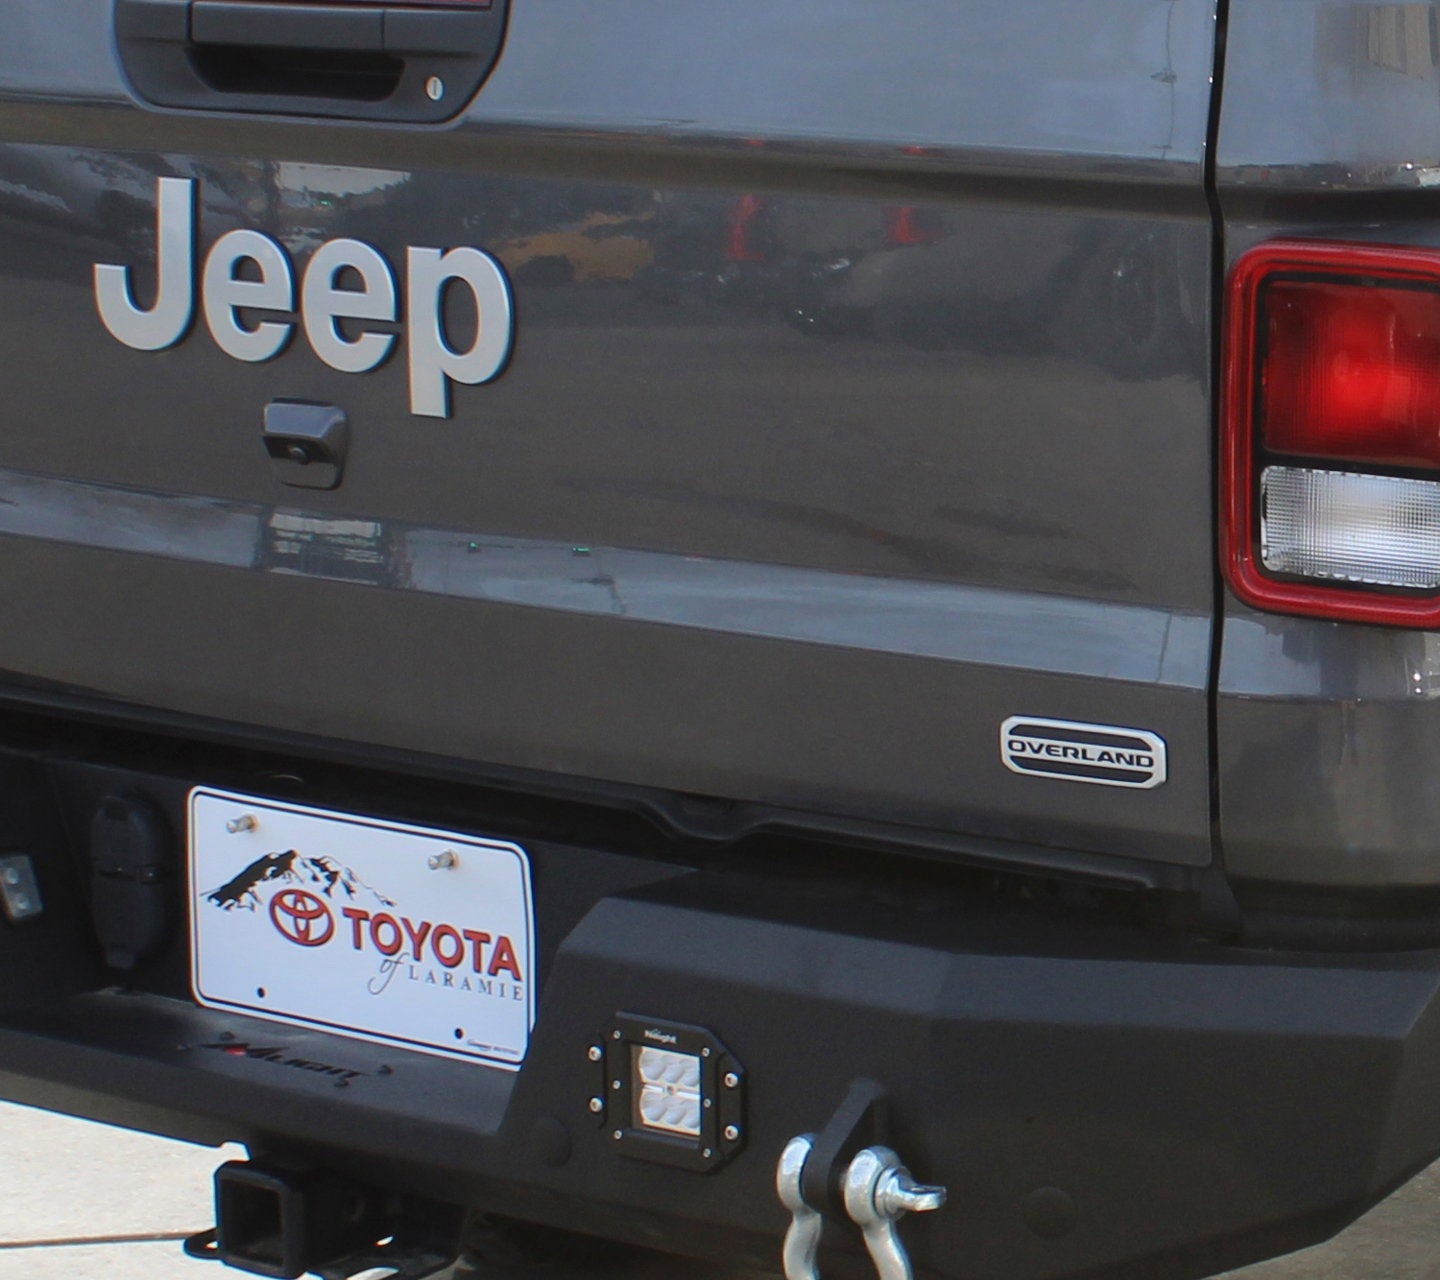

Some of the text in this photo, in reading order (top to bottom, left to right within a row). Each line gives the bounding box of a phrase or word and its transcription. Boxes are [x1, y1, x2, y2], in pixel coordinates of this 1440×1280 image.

[93, 176, 515, 419] Jeep
[1007, 738, 1155, 769] OVERLAND
[341, 906, 523, 983] TOYOTA
[367, 952, 524, 1002] of LARAMIE
